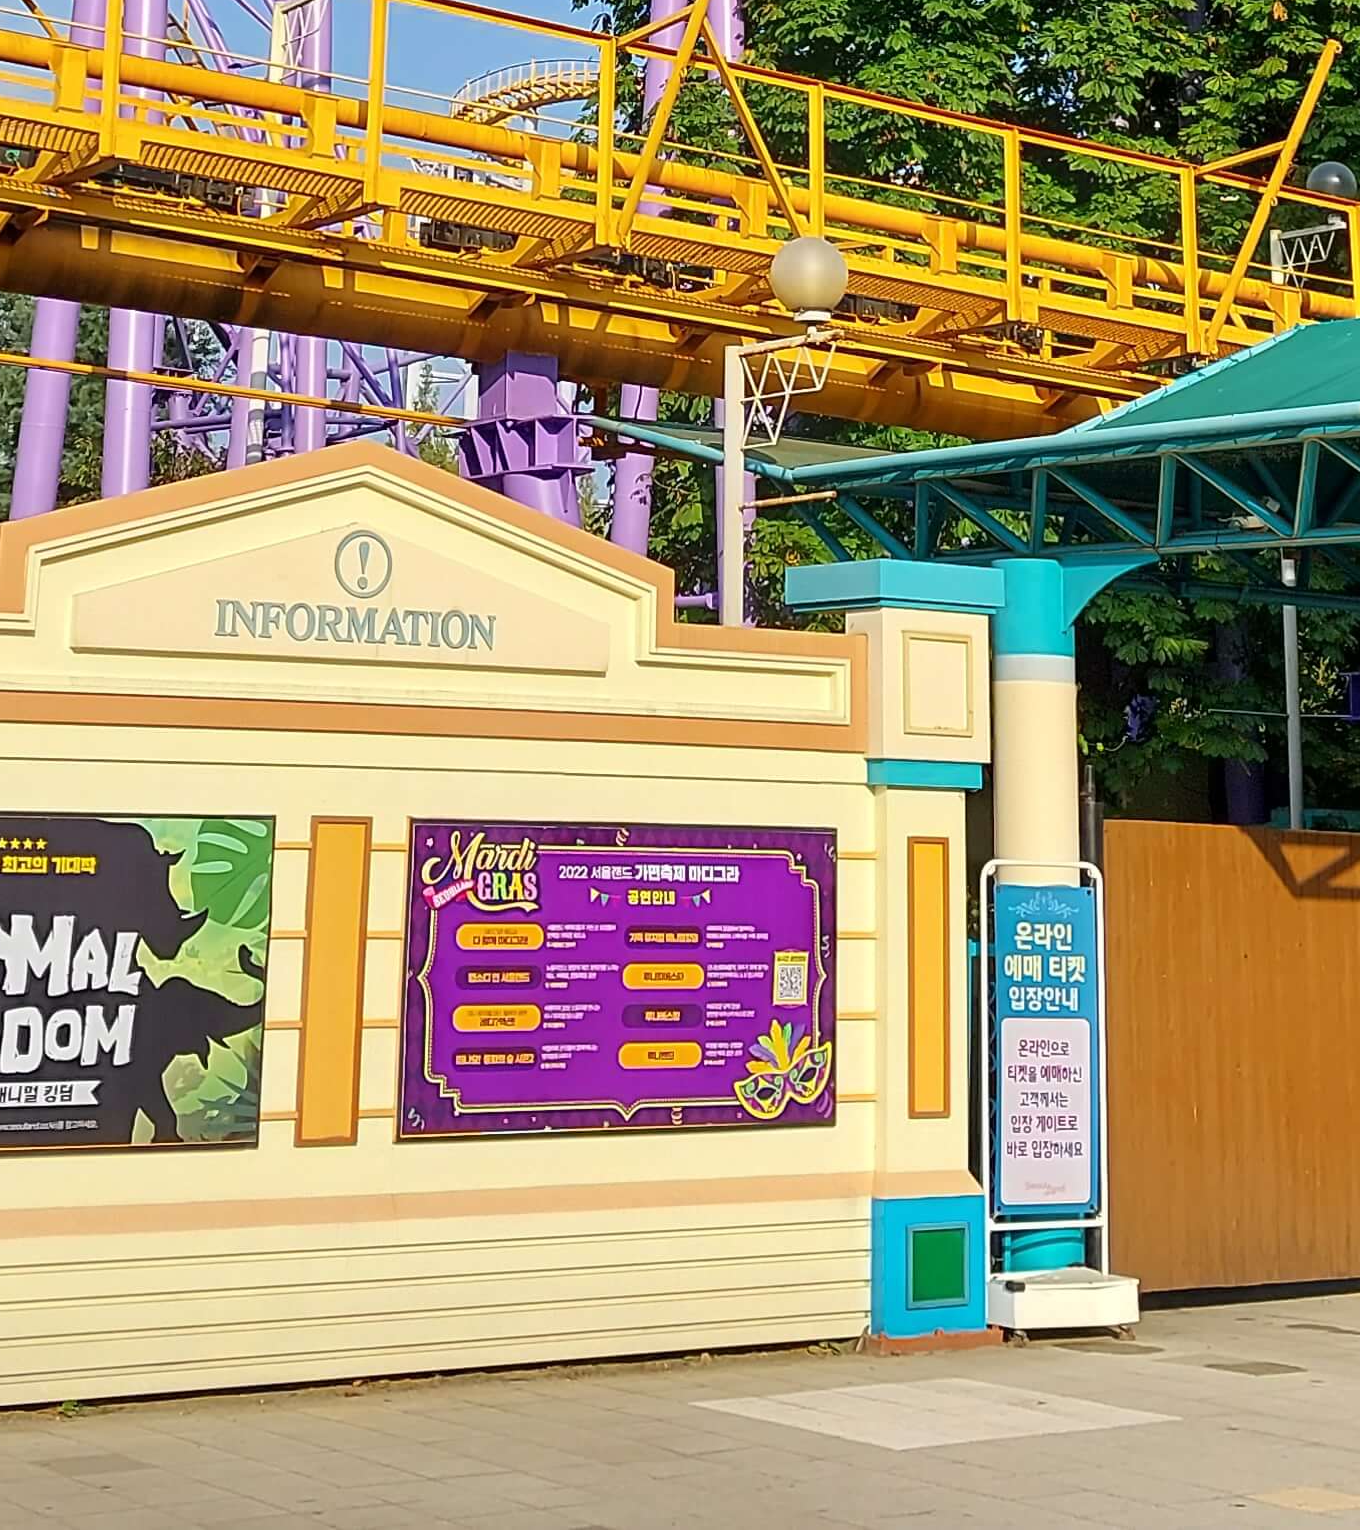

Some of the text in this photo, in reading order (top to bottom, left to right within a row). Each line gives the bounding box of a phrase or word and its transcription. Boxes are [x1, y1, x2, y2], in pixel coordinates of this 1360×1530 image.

[214, 598, 497, 651] INFORMATION
[1, 855, 48, 874] 최고의
[51, 856, 97, 875] 기대작
[421, 830, 537, 885] Mardi
[558, 865, 588, 880] 2022
[477, 871, 538, 901] GRAS
[1013, 921, 1073, 951] 온라인
[1003, 954, 1086, 983] 예매 티켓
[1008, 986, 1079, 1012] 입장안내
[1017, 1038, 1070, 1058] 온라인으로
[1007, 1064, 1082, 1083] 티켓을 예매하신
[42, 1083, 74, 1103] 킹덤
[1019, 1091, 1069, 1108] 고객께서는
[1010, 1114, 1079, 1134] 입장 게이트로
[1006, 1140, 1084, 1159] 바로 입장하세요
